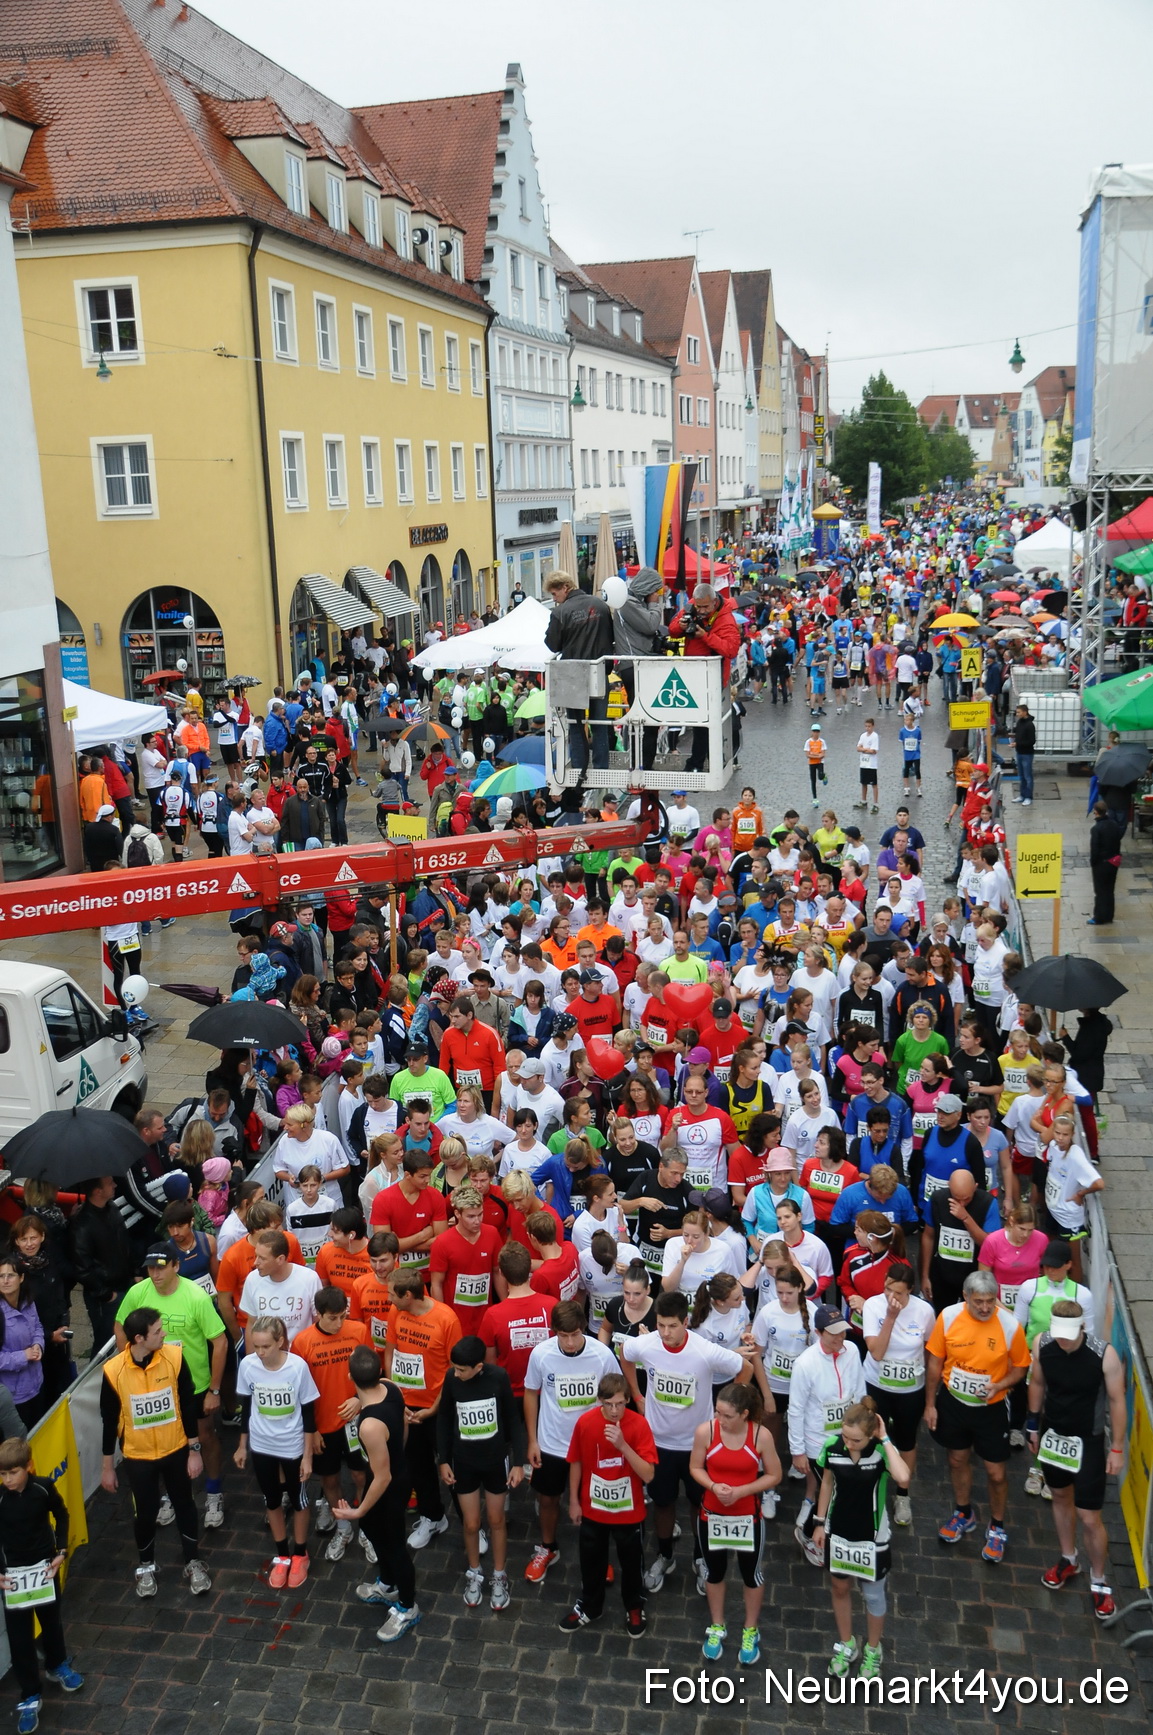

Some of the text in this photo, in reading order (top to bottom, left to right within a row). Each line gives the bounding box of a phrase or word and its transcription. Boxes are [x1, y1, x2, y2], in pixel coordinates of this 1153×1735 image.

[815, 416, 824, 468] HOTEL
[967, 657, 977, 672] A
[428, 851, 467, 868] 6352
[1018, 851, 1060, 864] Jugend-
[1029, 863, 1049, 874] lauf
[11, 895, 118, 920] Serviceline:
[123, 885, 171, 904] 09181
[176, 879, 219, 898] 6352
[458, 1075, 479, 1084] 5151
[814, 1171, 841, 1186] 5079
[943, 1234, 971, 1250] 5113
[301, 1245, 320, 1257] 512
[459, 1281, 487, 1295] 5158
[258, 1296, 304, 1311] BC 93
[528, 1316, 544, 1324] LEID
[409, 1330, 431, 1341] LAUFEN
[409, 1337, 428, 1348] DAVON
[330, 1346, 353, 1356] LAUFEN
[312, 1359, 329, 1367] NICHT
[395, 1360, 420, 1376] 5087
[883, 1365, 915, 1379] 5188
[560, 1382, 594, 1397] 5006
[657, 1380, 691, 1396] 5007
[135, 1396, 171, 1417] 5099
[258, 1392, 291, 1407] 5190
[461, 1409, 494, 1425] 5096
[1045, 1435, 1077, 1457] 5186
[594, 1485, 627, 1501] 5057
[713, 1524, 749, 1538] 5147
[834, 1548, 871, 1566] 5105
[10, 1569, 49, 1592] 5172
